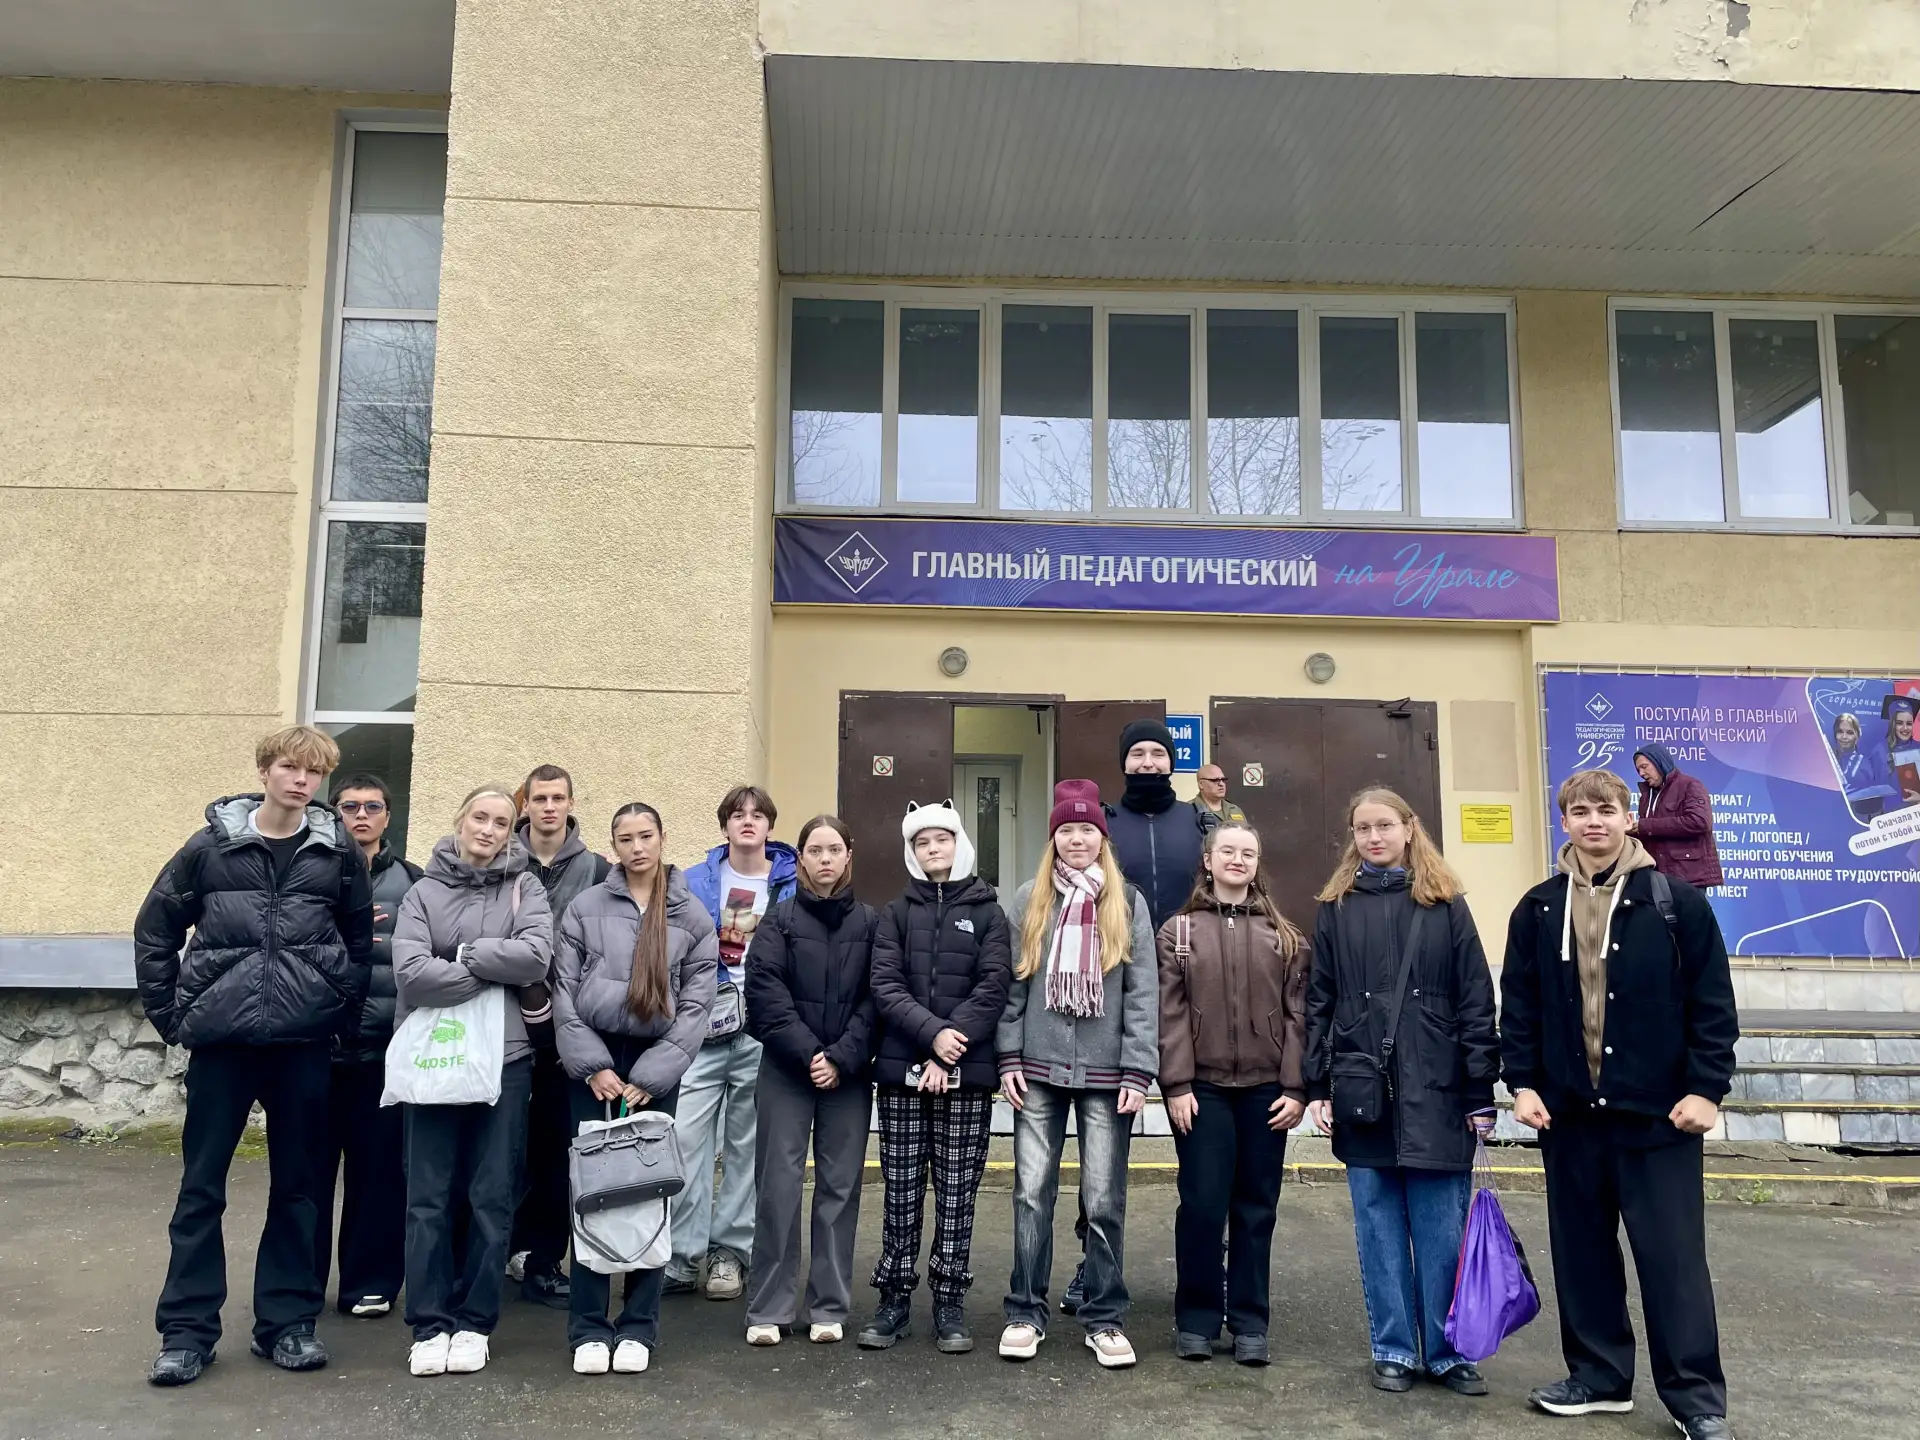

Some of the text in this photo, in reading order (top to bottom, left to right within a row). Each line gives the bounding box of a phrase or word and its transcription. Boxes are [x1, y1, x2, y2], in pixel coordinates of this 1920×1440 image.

[912, 542, 1520, 609] ГЛАВНЫЙ ПЕДАГОГИЧЕСКИЙ на Урале
[1634, 705, 1798, 724] ПОСТУПАЙ В ГЛАВНЫЙ
[1575, 732, 1625, 740] УНИВЕРСИТЕТ
[1635, 726, 1766, 743] ПЕДАГОГИЧЕСКИЙ
[1176, 747, 1191, 760] 12
[1572, 740, 1620, 769] 95
[1666, 746, 1707, 761] РАЛЕ
[1876, 813, 1913, 829] Сначала
[1749, 831, 1803, 845] ЛОГОПЕД
[1855, 836, 1881, 850] потом
[1882, 834, 1888, 842] с
[1888, 825, 1914, 840] тобой
[1774, 850, 1834, 863] ОБУЧЕНИЯ
[1722, 867, 1833, 881] ГАРАНТИРОВАННОЕ
[1717, 886, 1748, 898] МЕСТ
